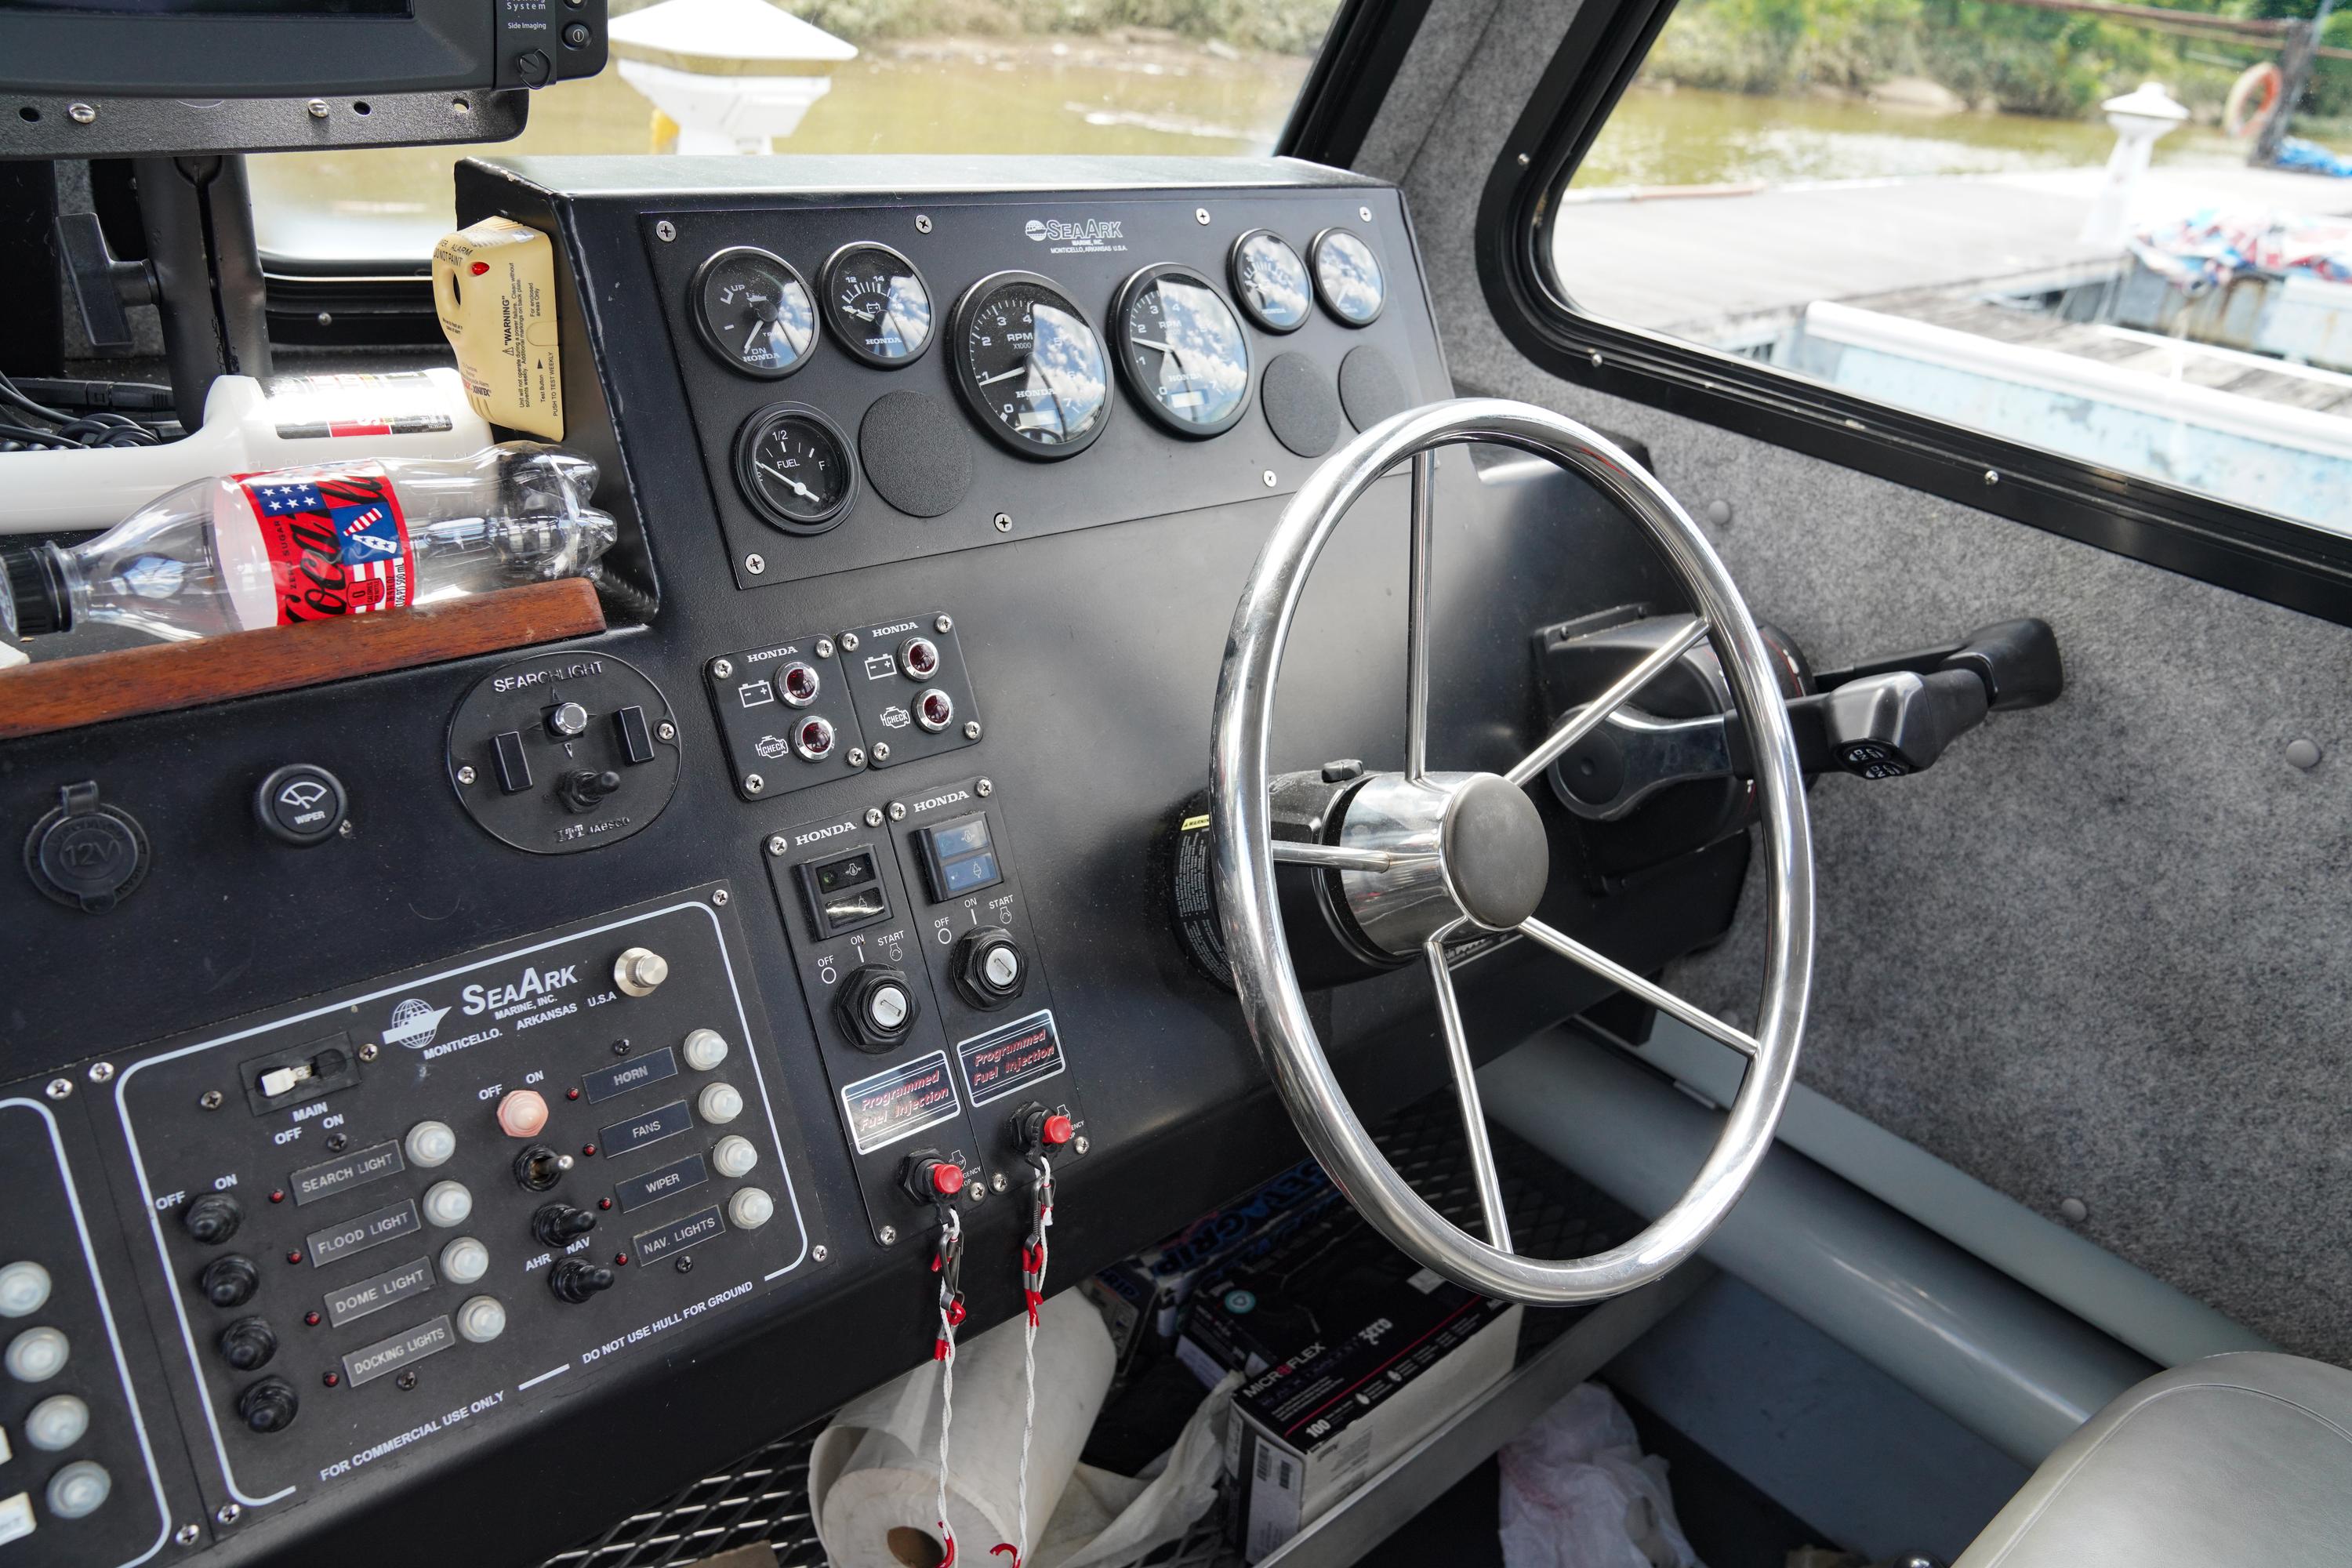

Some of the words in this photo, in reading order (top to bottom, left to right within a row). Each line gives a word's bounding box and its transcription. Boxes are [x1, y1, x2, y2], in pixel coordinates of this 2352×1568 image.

[507, 2, 546, 12] System
[451, 244, 473, 256] ALARM
[448, 253, 463, 267] PAINT
[996, 317, 1007, 326] 3
[1022, 315, 1033, 324] 4
[1159, 321, 1181, 329] RPM
[1007, 332, 1033, 342] RPM
[1138, 325, 1147, 333] 2
[982, 336, 992, 346] 2
[742, 354, 781, 362] HONDA
[1140, 357, 1146, 365] 1
[1015, 388, 1056, 398] HONDA
[1159, 387, 1167, 395] 0
[1004, 404, 1014, 413] 0
[1063, 397, 1072, 407] 7
[772, 430, 788, 441] 1/2
[777, 459, 800, 470] FUEL
[818, 461, 825, 470] F
[274, 521, 290, 556] SUGAR
[287, 561, 297, 589] ZERO
[395, 563, 405, 572] mL
[396, 574, 405, 585] 500
[872, 622, 919, 637] HONDA
[747, 646, 798, 662] HONDA
[494, 661, 603, 692] SEARCHLIGHT
[886, 712, 907, 724] CHECK
[763, 742, 785, 754] CHECK
[913, 790, 969, 812] HONDA
[295, 811, 325, 825] WIPER
[555, 824, 584, 842] ITT
[795, 822, 857, 846] HONDA
[65, 840, 116, 866] 12V
[935, 916, 949, 928] OFF
[964, 898, 978, 908] ON
[989, 895, 1014, 909] START
[818, 955, 835, 967] OFF
[850, 935, 864, 946] ON
[877, 931, 905, 946] START
[495, 1001, 536, 1020] MARINE,
[537, 994, 557, 1007] INC.
[517, 1004, 578, 1031] ARKANSAS
[974, 1029, 1047, 1068] Programmed
[973, 1066, 999, 1087] Fuel
[1005, 1044, 1054, 1074] Injection
[613, 1065, 648, 1087] HORN
[478, 1084, 503, 1101] OFF
[525, 1070, 544, 1085] ON
[862, 1070, 940, 1112] Programmed
[292, 1102, 328, 1123] MAIN
[860, 1111, 888, 1132] Fuel
[894, 1088, 949, 1116] Injection
[274, 1127, 303, 1145] OFF
[322, 1113, 344, 1129] ON
[633, 1120, 662, 1138] FANS
[301, 1167, 354, 1193] SEARCH
[358, 1153, 393, 1174] LIGHT
[963, 1167, 982, 1178] GENCY
[154, 1191, 186, 1210] OFF
[214, 1174, 238, 1191] ON
[645, 1173, 680, 1194] WIPER
[318, 1229, 365, 1254] FLOOD
[369, 1212, 408, 1236] LIGHT
[644, 1236, 670, 1254] NAV.
[673, 1218, 716, 1243] LIGHTS
[525, 1253, 552, 1272] AHR
[565, 1236, 591, 1254] NAV
[335, 1287, 379, 1313] DOME
[383, 1269, 424, 1294] LIGHT
[581, 1348, 602, 1364] DO
[602, 1338, 626, 1356] NOT
[627, 1327, 652, 1345] USE
[652, 1314, 683, 1336] HULL
[683, 1302, 707, 1321] FOR
[706, 1282, 754, 1312] GROUND
[354, 1345, 405, 1374] DOCKING
[407, 1328, 445, 1352] LIGHTS
[320, 1459, 352, 1481] FOR
[352, 1422, 441, 1468] COMMERCIAL
[442, 1407, 470, 1428] USE
[470, 1390, 506, 1416] ONLY
[1306, 1420, 1331, 1438] 100
